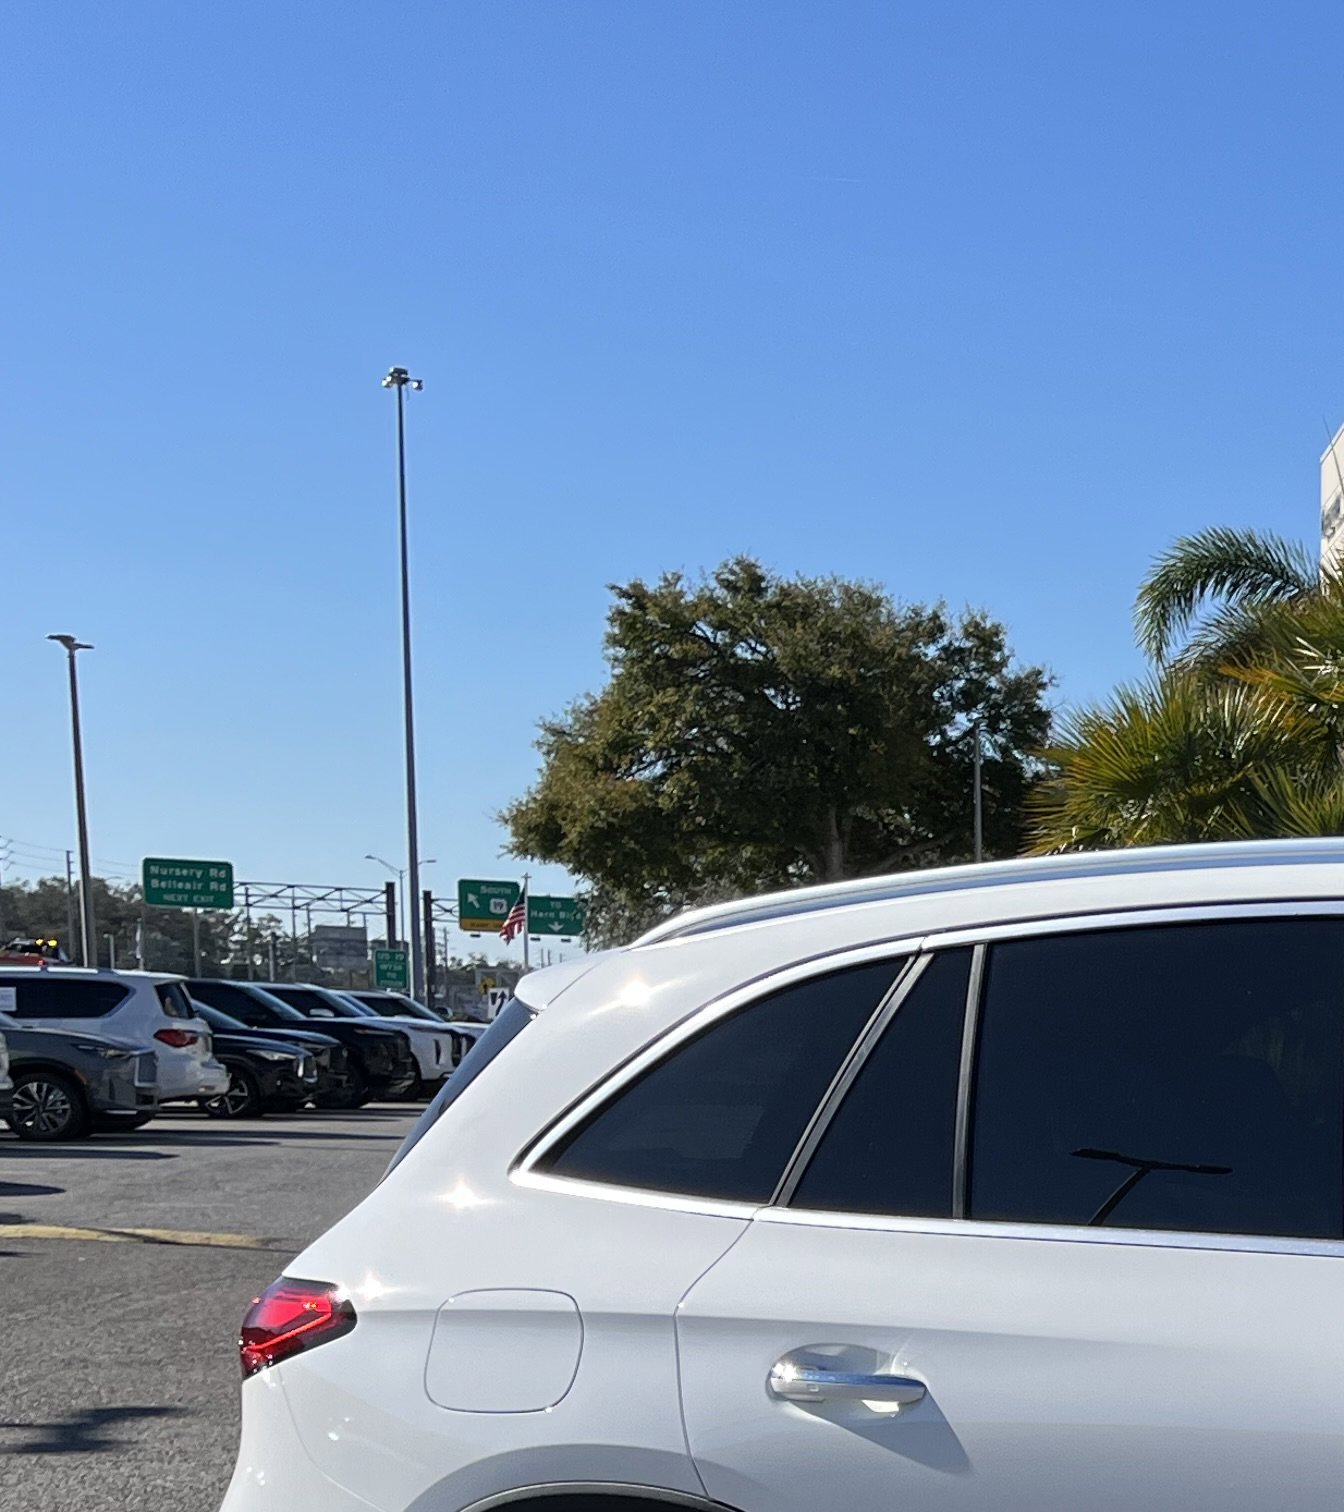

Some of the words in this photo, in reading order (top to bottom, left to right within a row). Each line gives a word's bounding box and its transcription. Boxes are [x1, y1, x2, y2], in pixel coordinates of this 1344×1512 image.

[149, 865, 204, 879] Nursery
[209, 868, 226, 879] Rd
[151, 879, 204, 890] Belleair
[209, 881, 227, 892] Rd
[163, 894, 189, 902] NEXT
[193, 895, 215, 903] EXIT
[493, 901, 504, 911] 19
